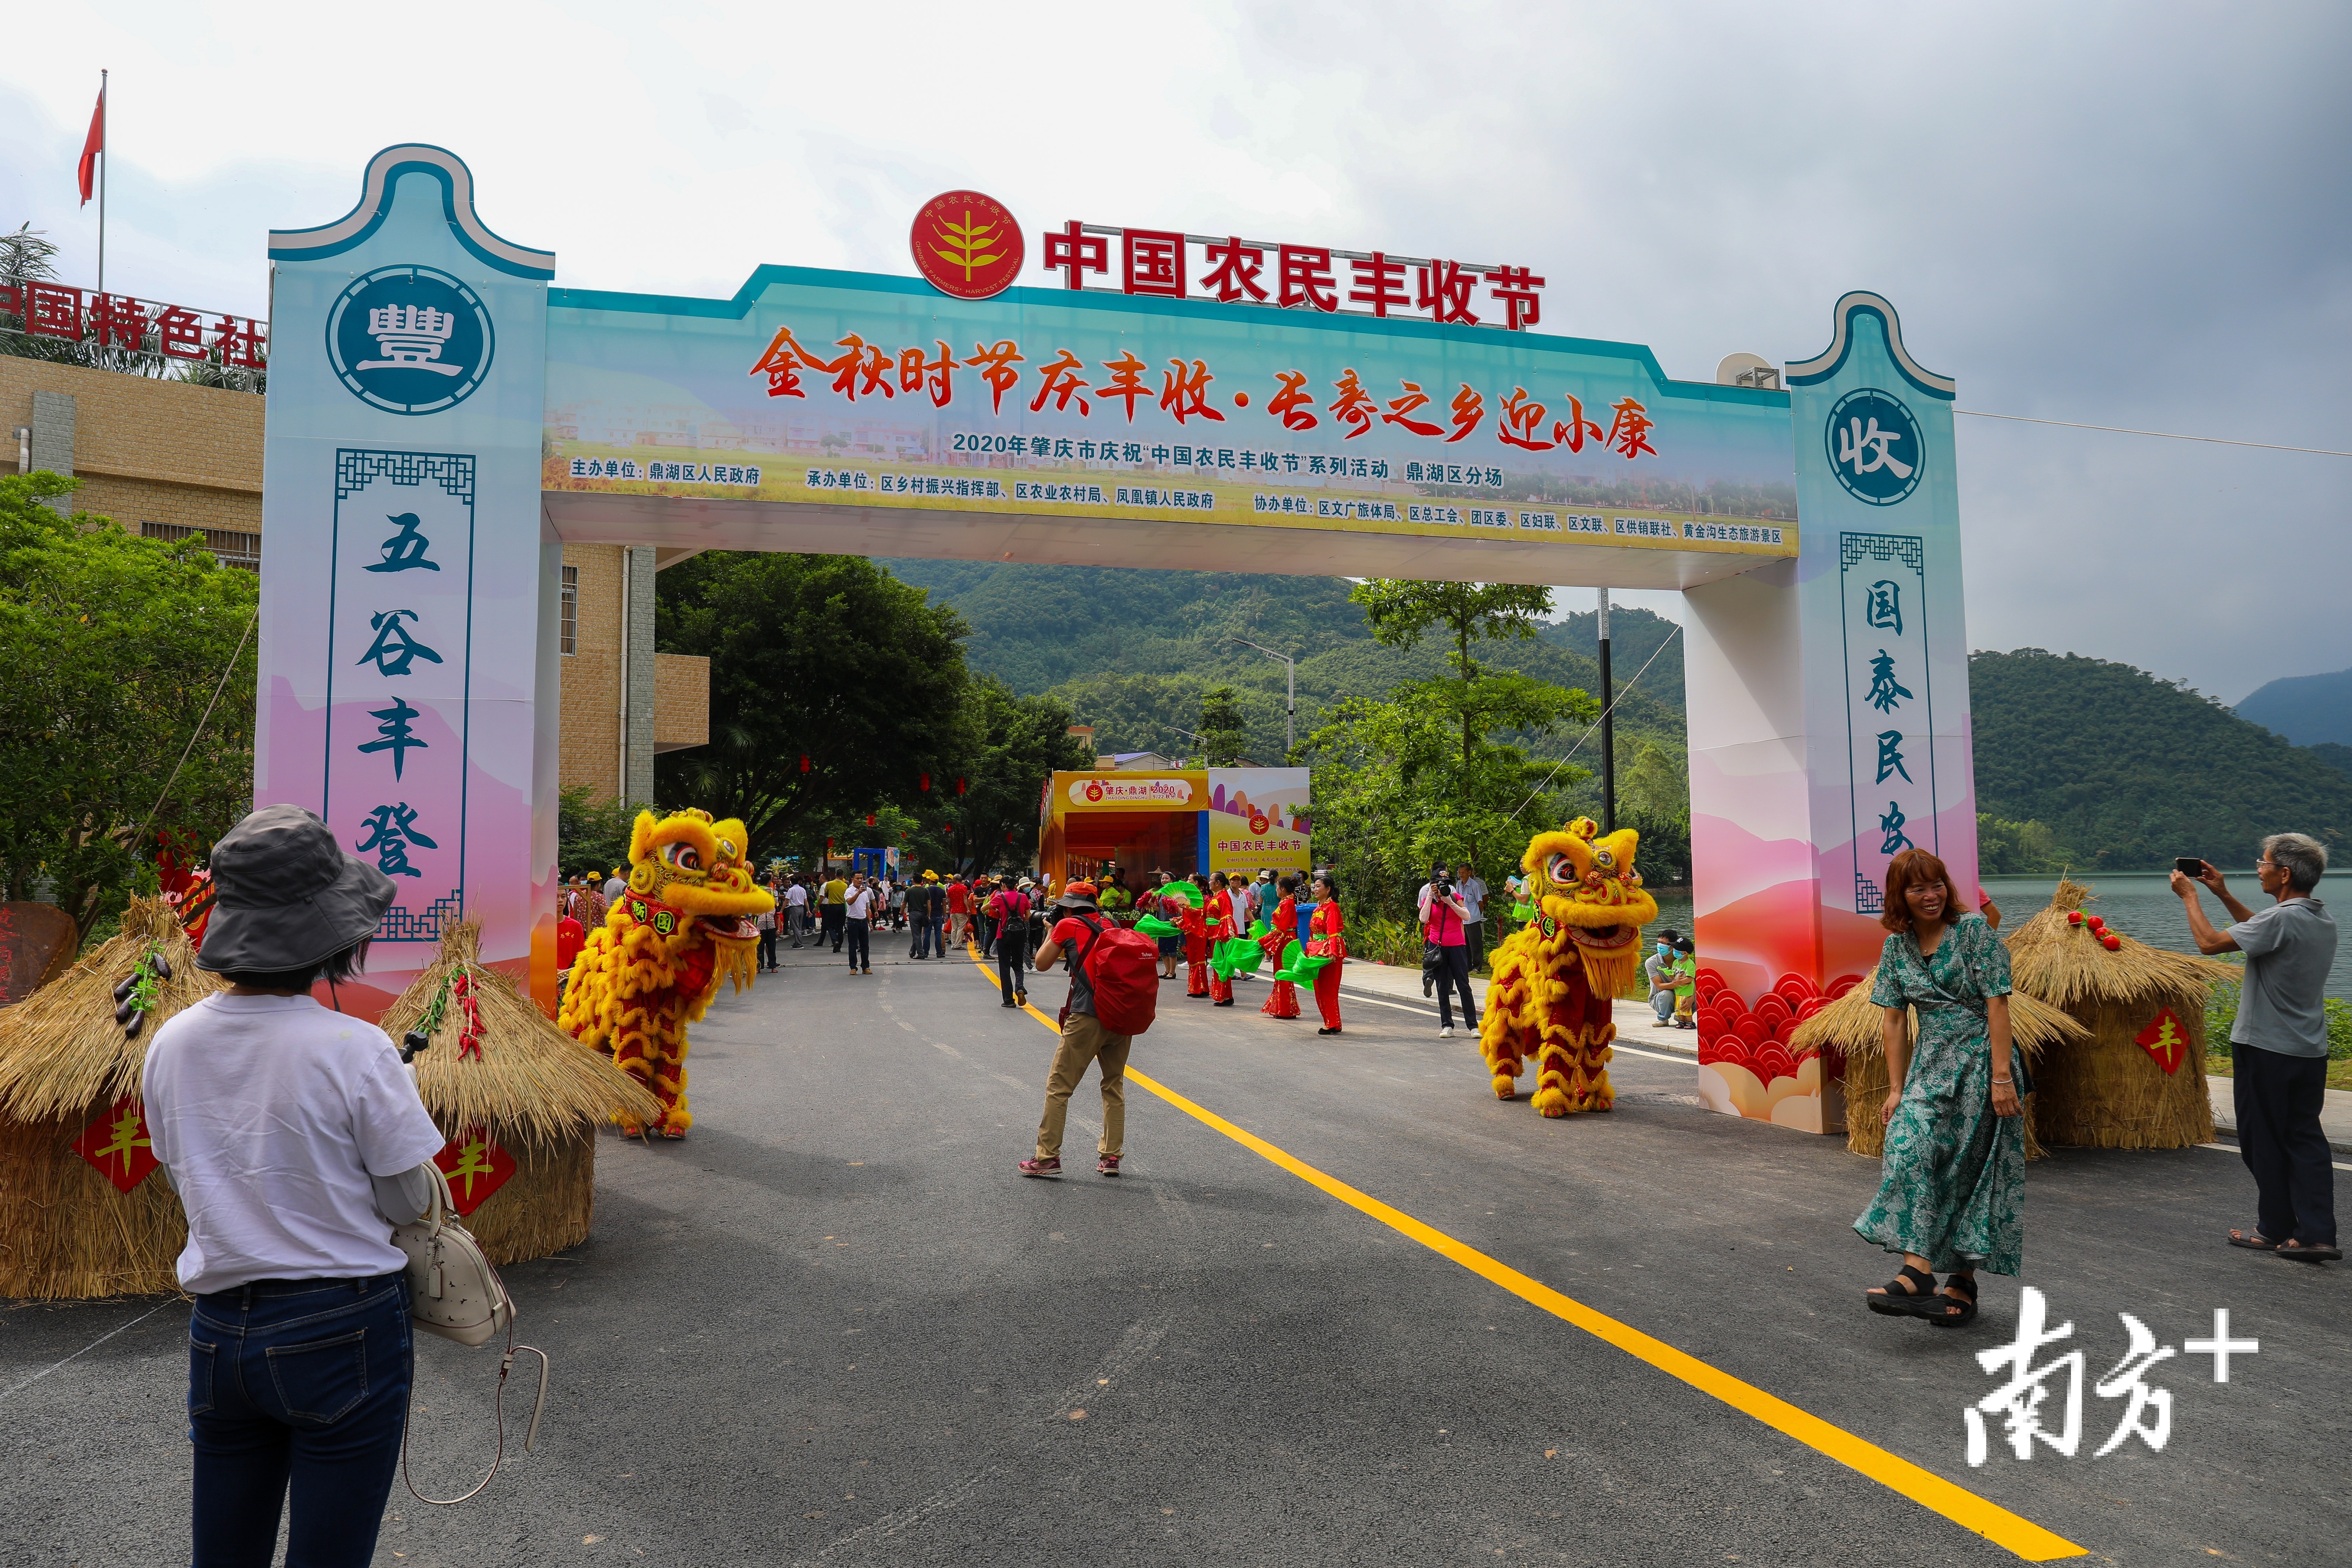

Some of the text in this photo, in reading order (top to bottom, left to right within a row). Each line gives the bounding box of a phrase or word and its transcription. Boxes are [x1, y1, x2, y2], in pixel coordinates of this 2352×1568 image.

[925, 195, 1011, 225] 中国农民丰收节
[915, 241, 929, 270] CHINESE
[965, 283, 998, 294] HARVEST
[999, 256, 1019, 285] FESTIVAL
[1044, 220, 1546, 331] 中国农民丰收节
[356, 304, 463, 376] 豐
[1406, 461, 1503, 487] 鼎湖区分场
[1839, 417, 1913, 479] 收
[355, 512, 443, 878] 五谷丰登
[1864, 579, 1914, 858] 国泰民安
[1218, 840, 1301, 852] 中国农民丰收节
[2150, 1016, 2182, 1065] 丰
[94, 1108, 151, 1178] 丰
[443, 1134, 494, 1201] 丰
